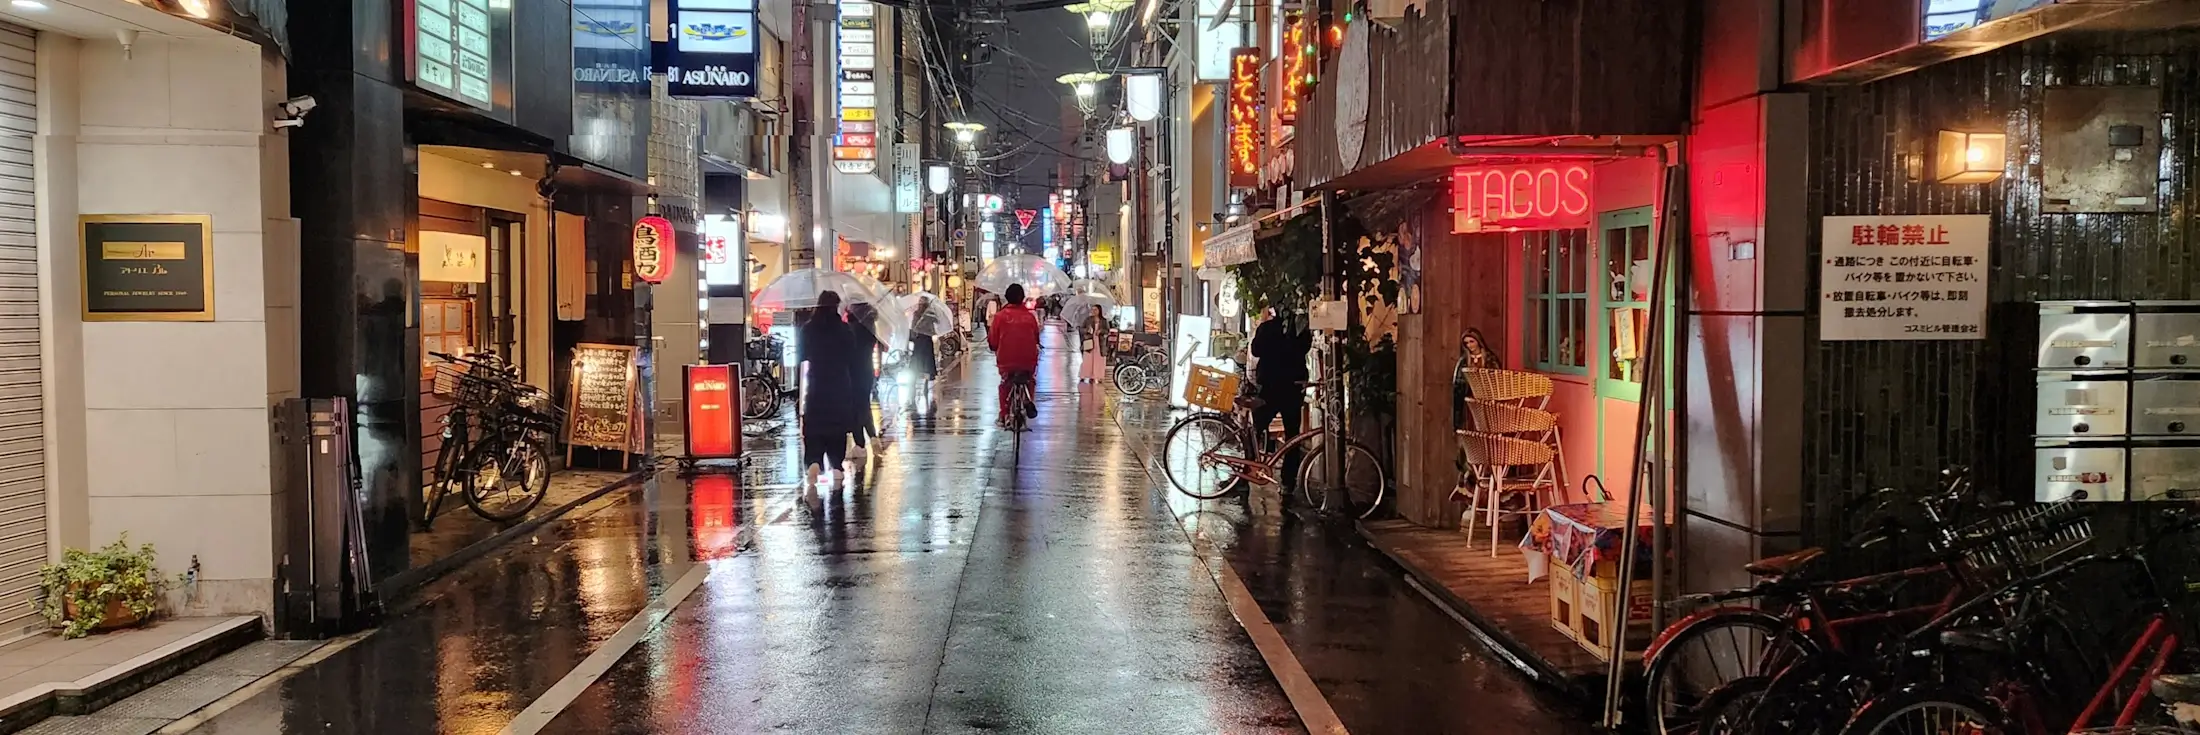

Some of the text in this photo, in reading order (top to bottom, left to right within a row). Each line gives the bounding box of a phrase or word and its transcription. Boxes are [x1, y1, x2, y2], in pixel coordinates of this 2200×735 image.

[452, 25, 458, 41] 3
[669, 22, 677, 39] 1
[452, 49, 459, 65] 2
[683, 71, 751, 87] ASUNARO
[901, 149, 913, 208] 川村ビル
[1455, 166, 1588, 222] TACOS
[1852, 224, 1950, 246] 駐輪禁止
[1834, 256, 1884, 267] 通路につき
[1845, 271, 1979, 283] バイク等を 置かないで下さい。
